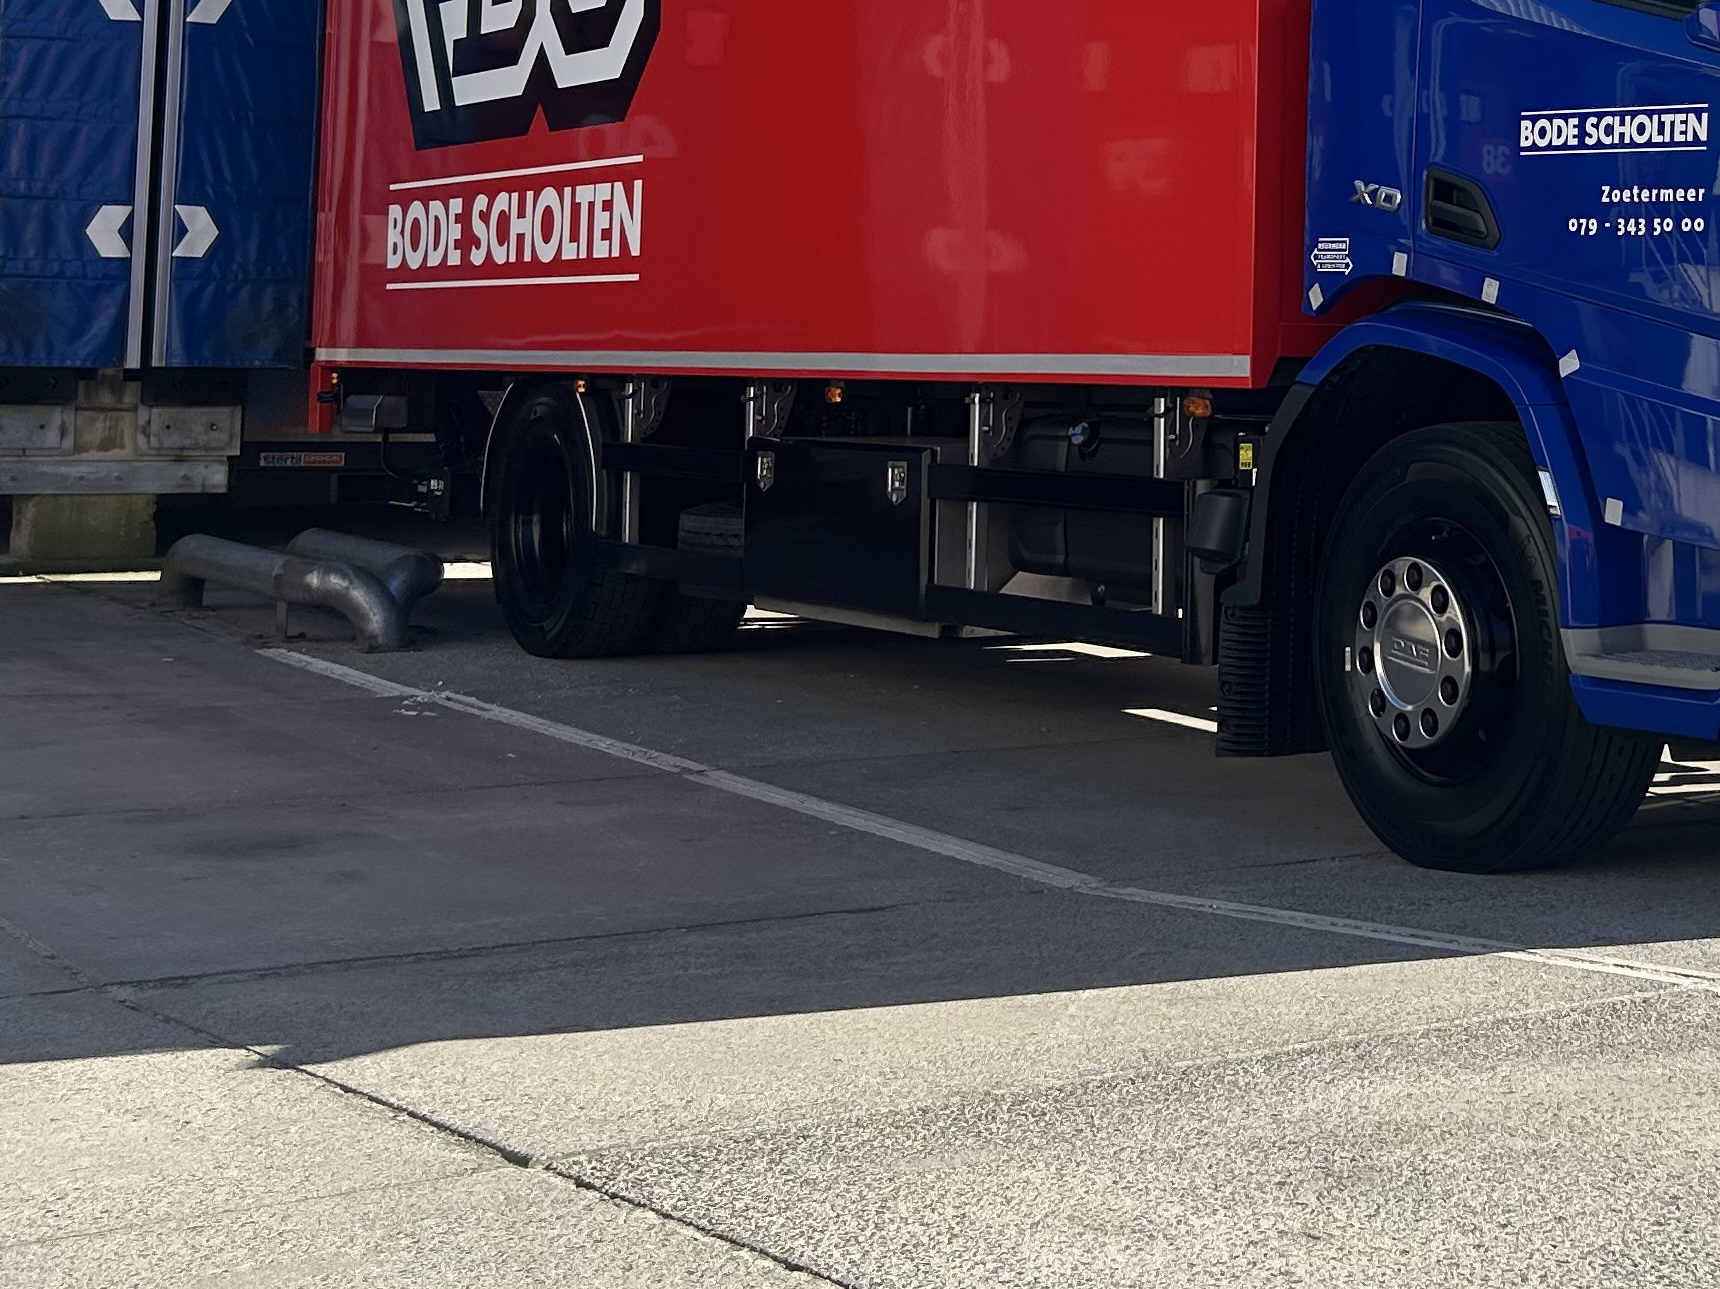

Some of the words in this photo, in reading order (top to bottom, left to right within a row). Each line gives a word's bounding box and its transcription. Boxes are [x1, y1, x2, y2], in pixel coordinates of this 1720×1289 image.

[1520, 116, 1579, 147] BODE
[1585, 112, 1709, 146] SCHOLTEN
[1601, 186, 1705, 202] Zoetermeer
[387, 197, 463, 270] BODE
[470, 180, 643, 266] SCHOLTEN
[1568, 218, 1598, 235] 079
[1617, 218, 1646, 235] 343
[1653, 218, 1673, 235] 50
[1681, 218, 1705, 232] 00
